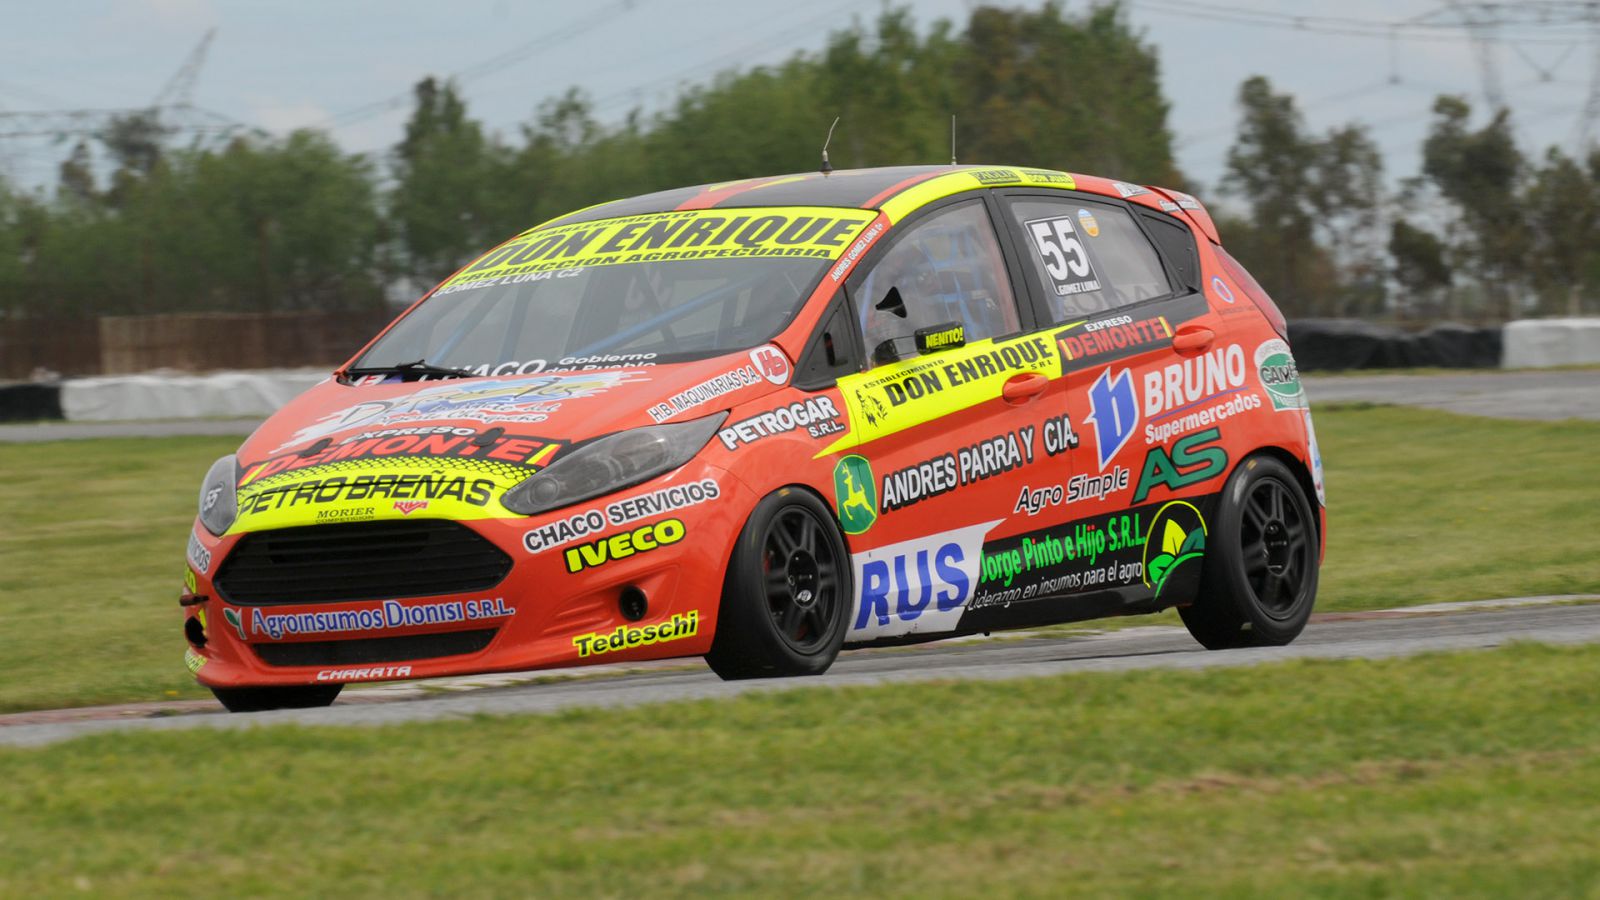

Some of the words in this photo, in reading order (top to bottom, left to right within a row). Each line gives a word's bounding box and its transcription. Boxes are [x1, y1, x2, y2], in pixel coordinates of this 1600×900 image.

[451, 255, 621, 285] PRODUCCION
[624, 249, 831, 262] AGROPECUARIA
[465, 227, 609, 273] DON
[595, 215, 868, 254] ENRIQUE
[831, 257, 852, 282] ANDRES
[848, 239, 867, 260] GOMEZ
[863, 228, 879, 243] LUNA
[1031, 219, 1089, 280] 55
[431, 278, 501, 298] GOMEZ
[499, 271, 553, 285] LUNA
[556, 267, 585, 278] C2
[1058, 281, 1081, 295] GOMEZ
[1082, 280, 1100, 292] LUNA
[1068, 320, 1165, 359] DEMONTE
[1085, 315, 1132, 332] EXPRESO
[559, 352, 657, 365] Gobierno
[863, 358, 945, 389] ESTABLECIMIENTO
[884, 370, 943, 407] DON
[945, 337, 1053, 387] ENRIQUE
[1144, 344, 1246, 417] BRUNO
[650, 404, 676, 422] H.B.
[671, 371, 742, 411] MAQUINARIAS
[738, 366, 760, 384] S.A.
[1145, 393, 1261, 444] Supermercados
[342, 426, 475, 444] EXPRESO
[718, 396, 839, 450] PETROGAR
[808, 421, 845, 438] S.R.L.
[882, 457, 957, 510] ANDRES
[959, 434, 1021, 483] PARRA
[1021, 427, 1034, 460] Y
[1043, 416, 1078, 453] CIA.
[1131, 427, 1228, 505] AS
[240, 476, 349, 515] PETRO
[346, 470, 494, 506] BREÑAS
[316, 507, 375, 519] MORIER
[1014, 486, 1062, 515] Agro
[1066, 466, 1128, 501] Simple
[525, 511, 604, 551] CHACO
[608, 480, 719, 523] SERVICIOS
[565, 519, 685, 573] IVECO
[981, 549, 1021, 587] Jorge
[1022, 535, 1064, 571] Pinto
[1064, 535, 1075, 560] e
[1075, 524, 1105, 565] Hijo
[1107, 513, 1147, 551] S.R.L.
[854, 543, 970, 630] RUS
[968, 587, 1020, 610] Liderazgo
[1022, 583, 1038, 599] en
[1038, 572, 1081, 594] insumos
[1081, 568, 1105, 590] para
[1107, 560, 1118, 581] el
[1120, 561, 1143, 584] agro
[252, 607, 383, 638] Agroinsumos
[383, 600, 463, 628] Dionisi
[467, 598, 515, 618] S.R.L.
[574, 613, 697, 656] Tedeschi
[317, 666, 412, 680] CHARATA
